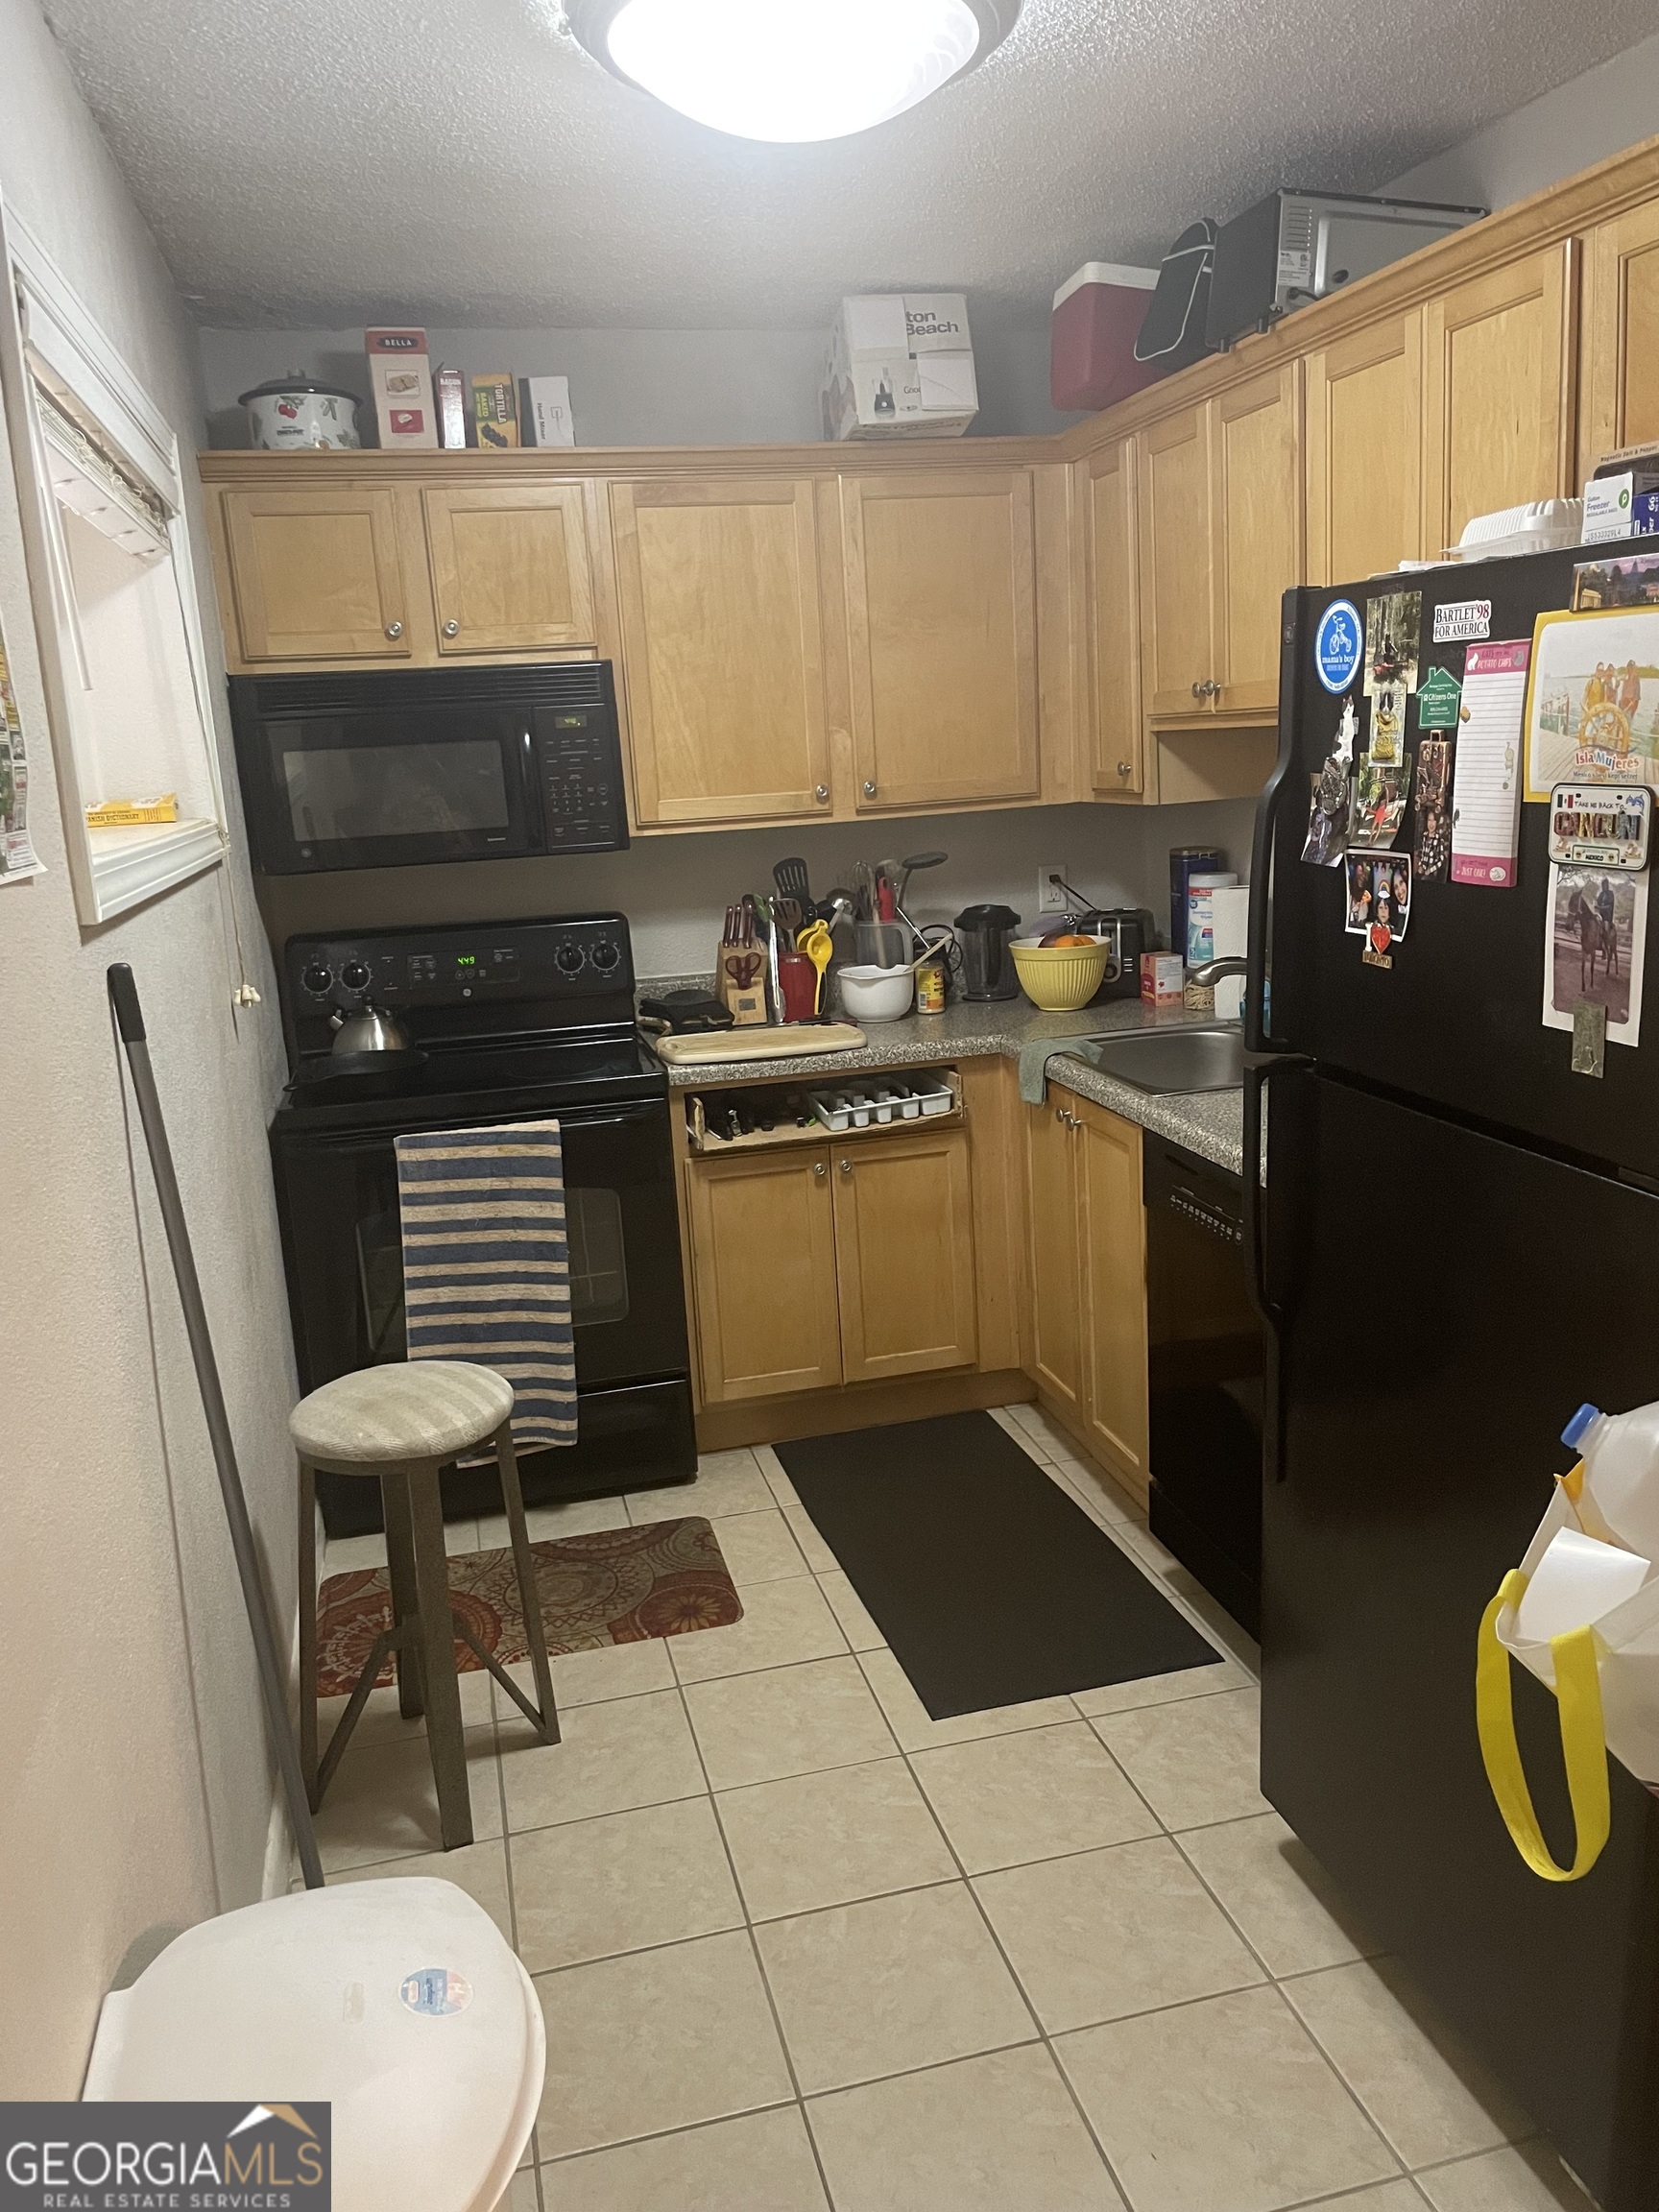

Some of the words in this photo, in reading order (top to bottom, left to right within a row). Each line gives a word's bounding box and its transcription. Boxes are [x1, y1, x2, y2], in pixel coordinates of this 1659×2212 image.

[906, 322, 959, 336] Beach
[493, 383, 507, 424] TORTILLA
[1587, 501, 1610, 512] Freezer
[1436, 607, 1476, 623] BARTLET
[1434, 625, 1451, 637] FOR
[1452, 622, 1488, 636] AMERICA
[1322, 655, 1343, 663] mama's
[1344, 654, 1355, 664] boy
[1575, 751, 1594, 764] Isla
[1595, 751, 1640, 770] Mujeres
[1553, 811, 1641, 840] CANCUN
